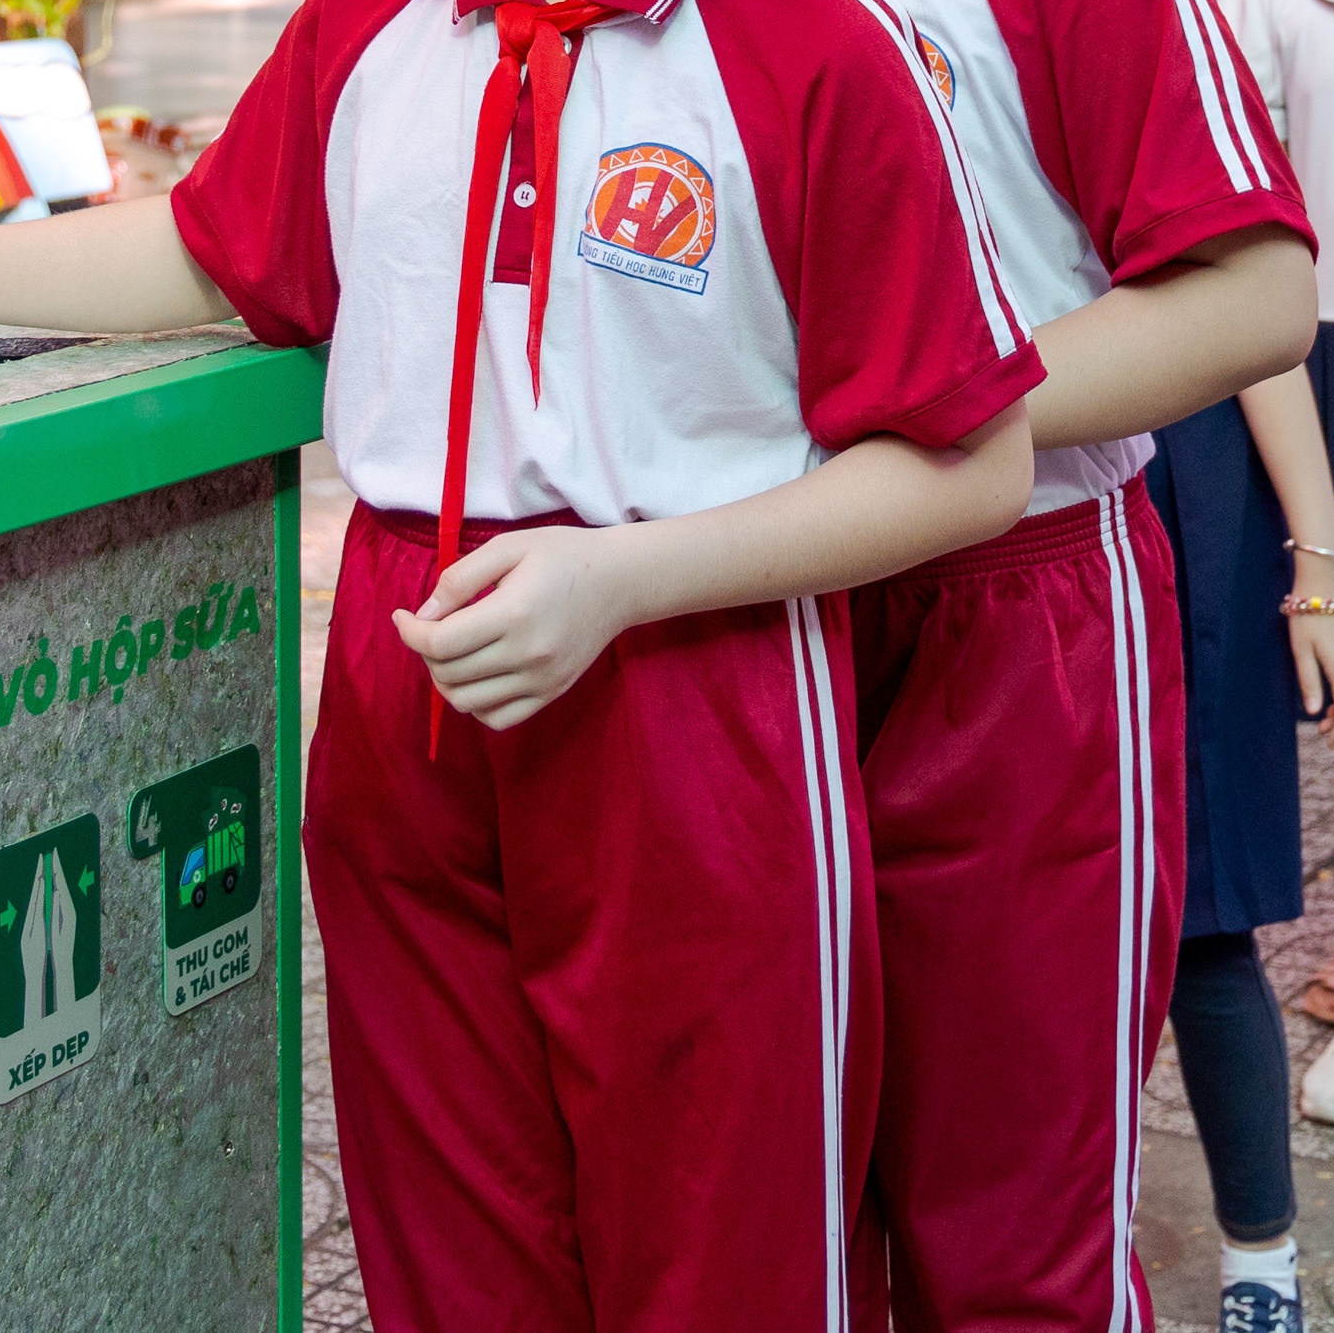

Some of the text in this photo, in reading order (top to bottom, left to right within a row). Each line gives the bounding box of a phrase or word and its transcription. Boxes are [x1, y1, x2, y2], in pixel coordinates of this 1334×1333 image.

[625, 259, 646, 274] HỌC
[679, 273, 701, 288] VIỆT
[68, 614, 165, 705] HỘP
[170, 580, 261, 661] SỮA
[135, 794, 162, 848] 4
[175, 944, 252, 1007] & TÁI CHẾ
[176, 926, 249, 978] THU GOM
[8, 1030, 90, 1091] XẾP DẸP
